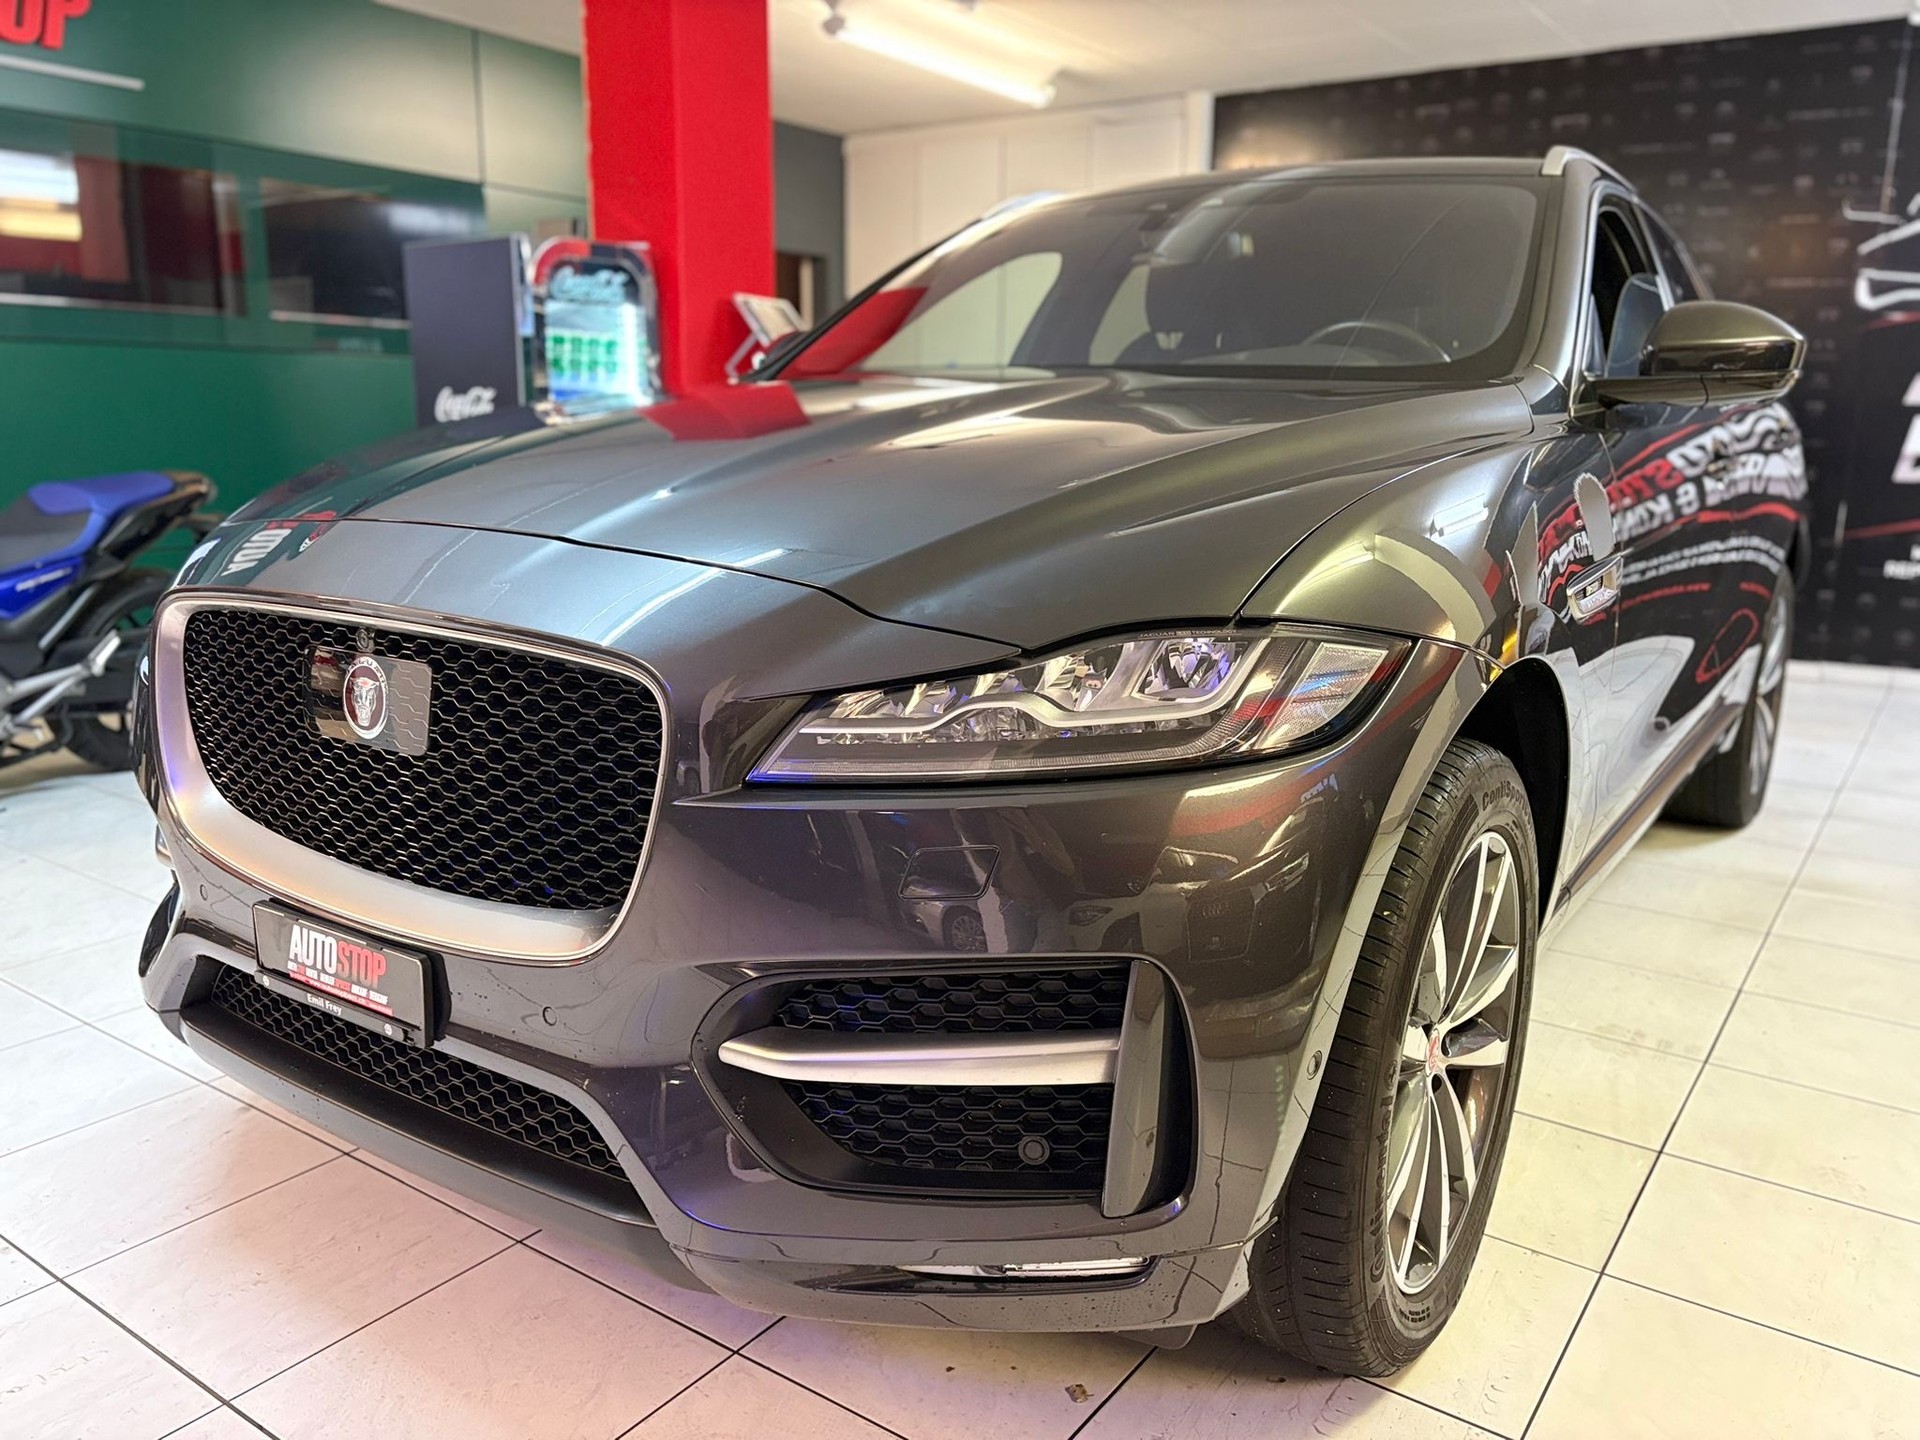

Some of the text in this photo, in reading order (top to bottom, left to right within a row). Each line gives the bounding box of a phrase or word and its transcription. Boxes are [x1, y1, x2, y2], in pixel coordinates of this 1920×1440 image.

[289, 924, 387, 989] AUTOSTOP
[306, 992, 342, 1016] Emil Frey
